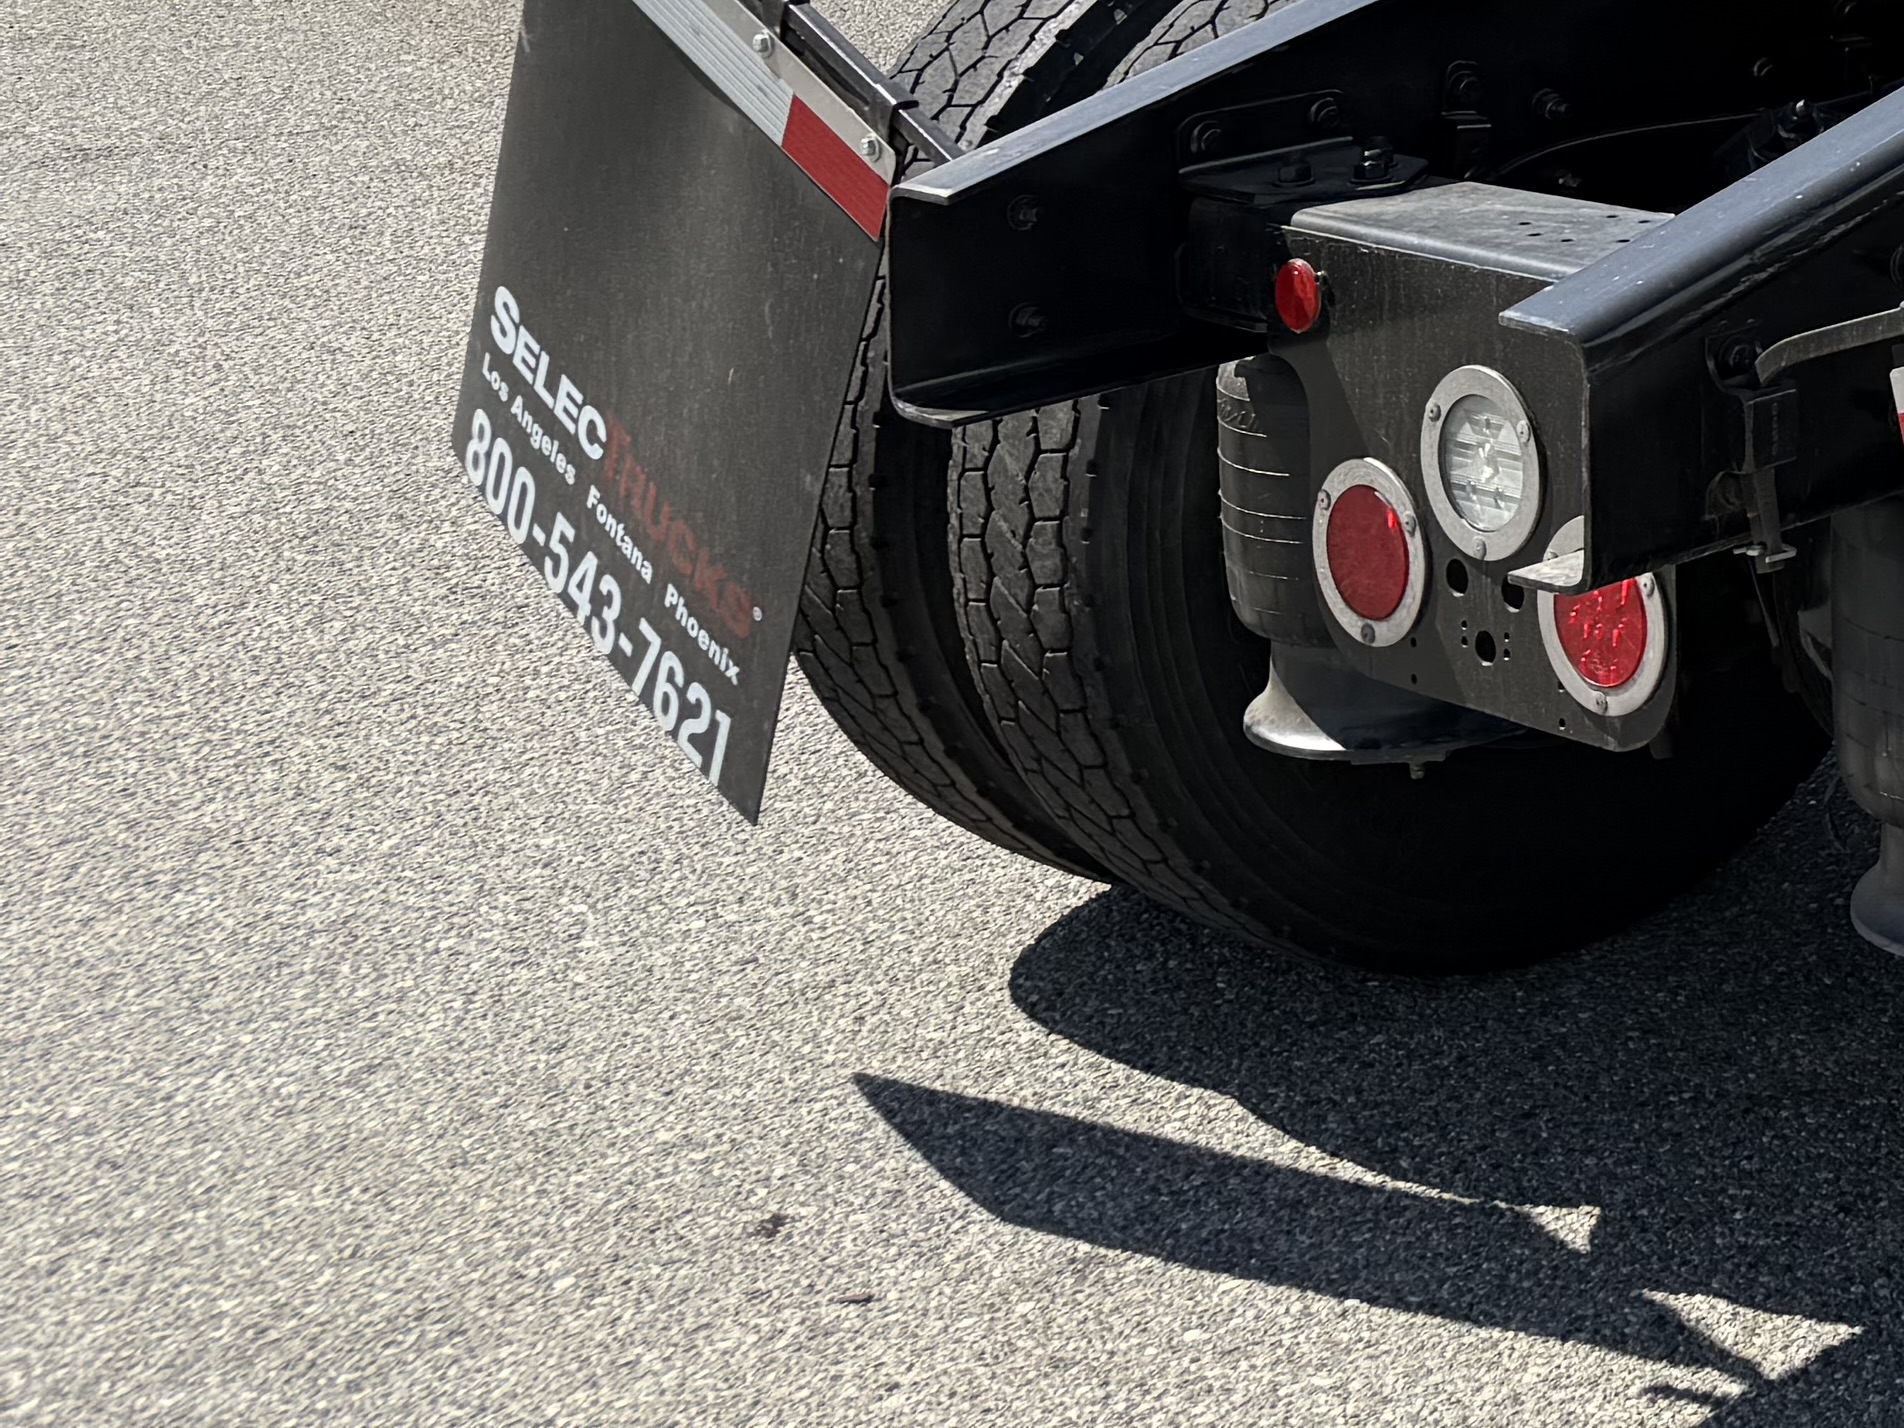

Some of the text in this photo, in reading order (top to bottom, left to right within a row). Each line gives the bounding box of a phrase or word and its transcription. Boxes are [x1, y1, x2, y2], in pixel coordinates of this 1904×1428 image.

[465, 408, 732, 786] 800-543-7621
[482, 351, 741, 686] Los Angeles Fontana Phoenix
